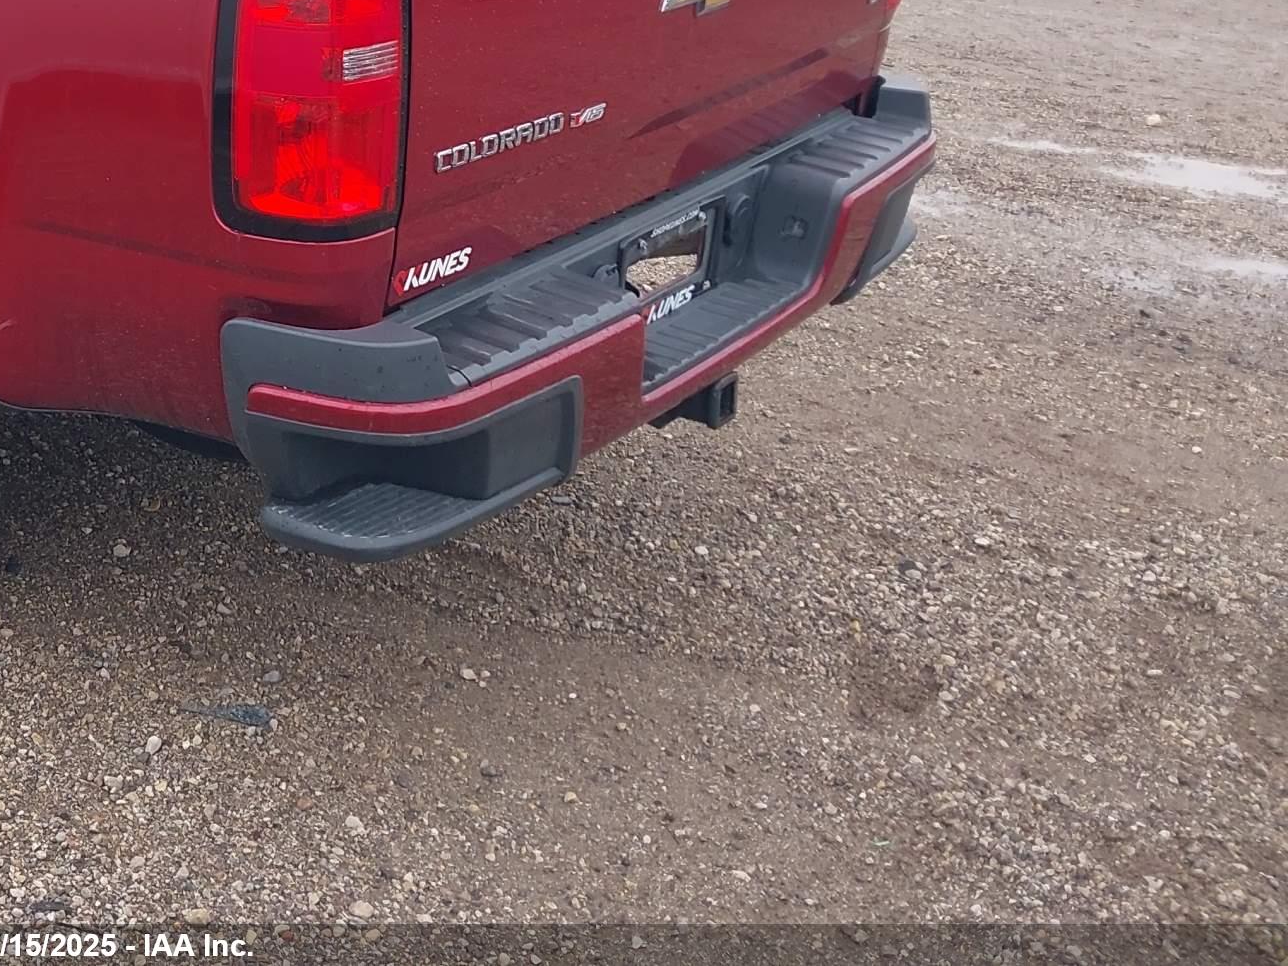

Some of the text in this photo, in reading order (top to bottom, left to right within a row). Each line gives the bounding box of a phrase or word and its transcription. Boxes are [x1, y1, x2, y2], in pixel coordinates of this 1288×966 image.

[435, 102, 607, 173] COLORADO V6
[402, 246, 473, 292] KUNES
[646, 284, 696, 325] KUNES
